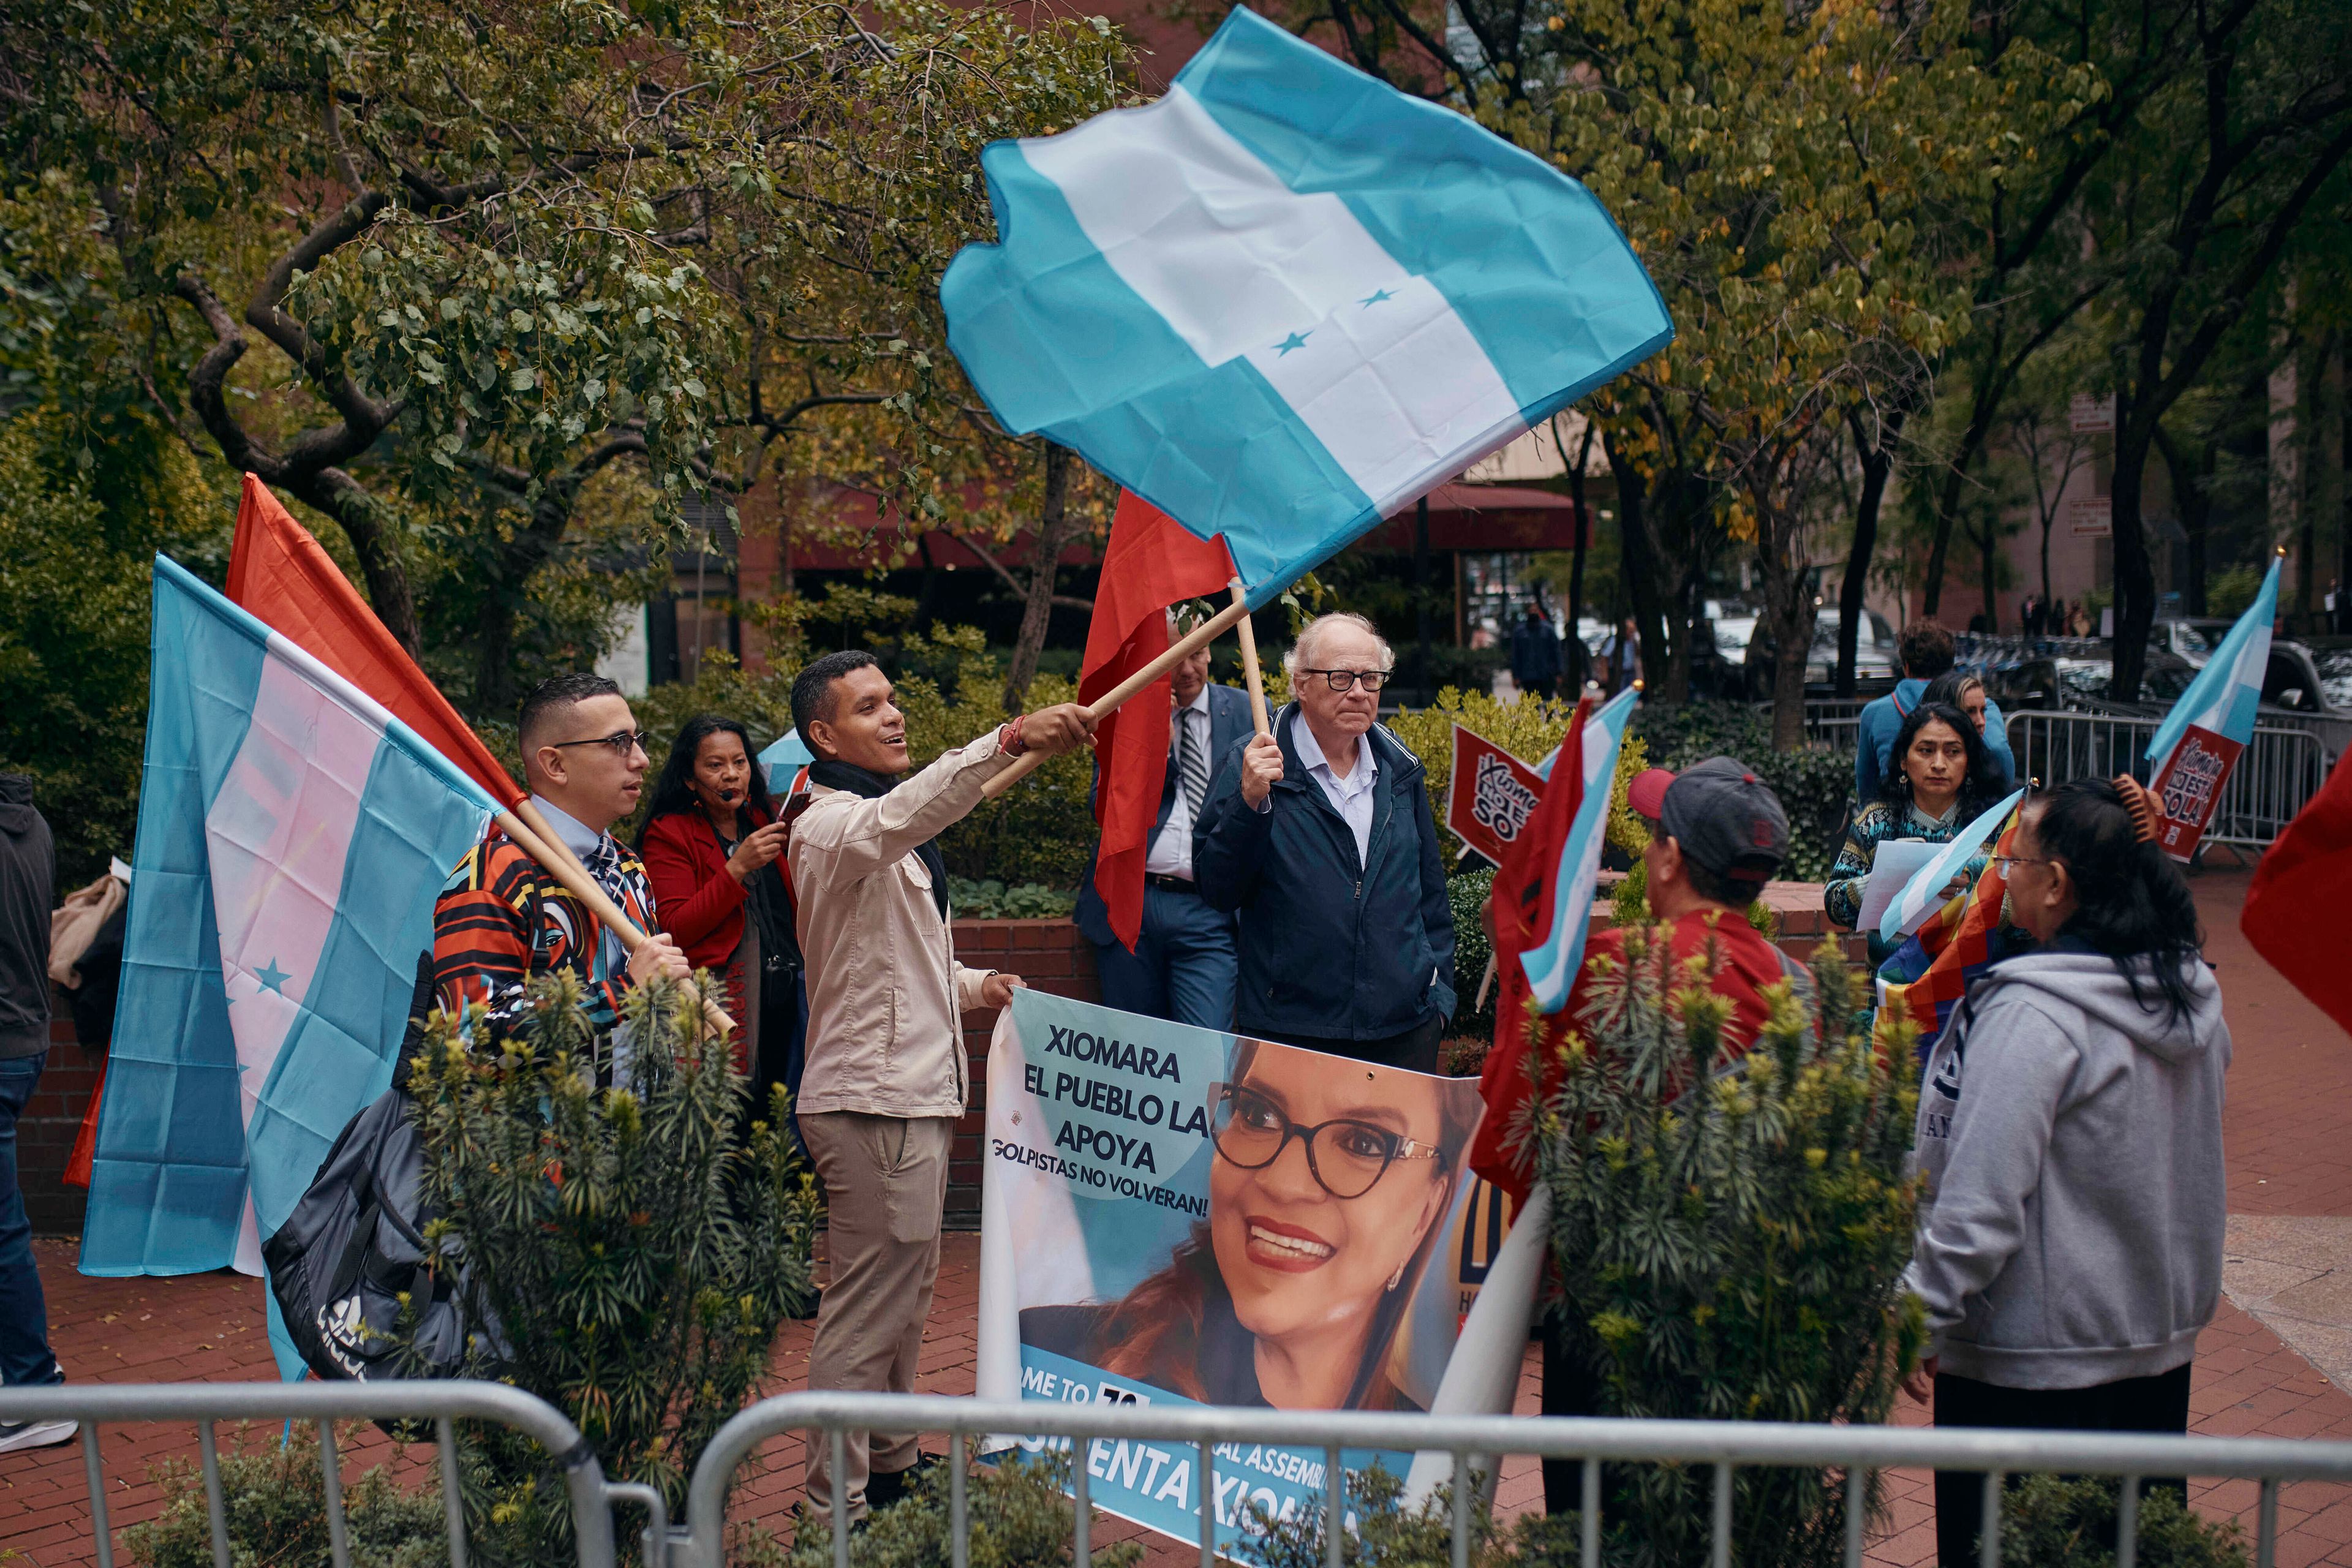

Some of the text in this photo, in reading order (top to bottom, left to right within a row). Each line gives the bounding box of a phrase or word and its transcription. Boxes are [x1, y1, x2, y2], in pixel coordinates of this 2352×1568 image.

[2169, 772, 2187, 789] NO
[1044, 1024, 1181, 1084] XIOMARA
[1025, 1063, 1049, 1098] EL
[1055, 1072, 1164, 1125] PUEBLO
[1169, 1100, 1209, 1139] LA
[1055, 1120, 1156, 1174] APOYA
[992, 1139, 1209, 1218] GOLPISTAS NO VOLVERAN!
[1020, 1366, 1058, 1397] ME
[1061, 1378, 1090, 1406] TO
[1244, 1444, 1329, 1491] ASSEMBL
